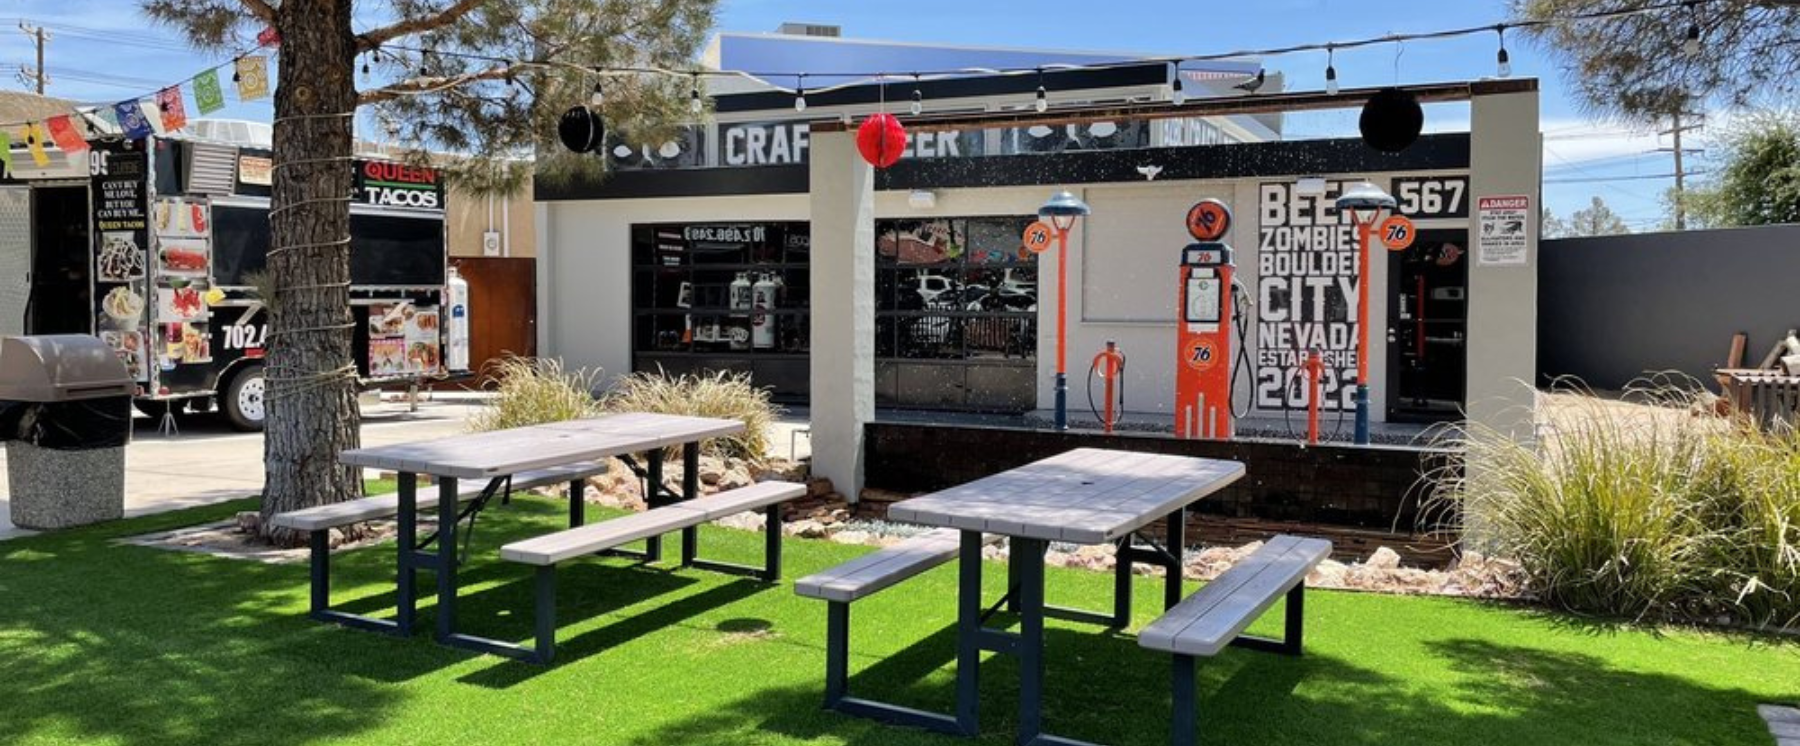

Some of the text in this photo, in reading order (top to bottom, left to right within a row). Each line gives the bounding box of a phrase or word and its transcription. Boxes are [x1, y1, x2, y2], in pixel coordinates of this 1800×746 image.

[726, 124, 960, 165] CRAF ER
[363, 161, 435, 183] QUEEN
[364, 186, 438, 208] TACOS
[1399, 180, 1465, 214] 567
[1490, 199, 1527, 207] DANGER
[1030, 230, 1046, 245] 76
[1385, 225, 1407, 241] 76
[1197, 251, 1212, 262] 76
[1260, 277, 1359, 321] CITY
[1193, 345, 1211, 361] 76
[1258, 349, 1358, 367] ESTABSHE
[1258, 367, 1358, 409] 2022
